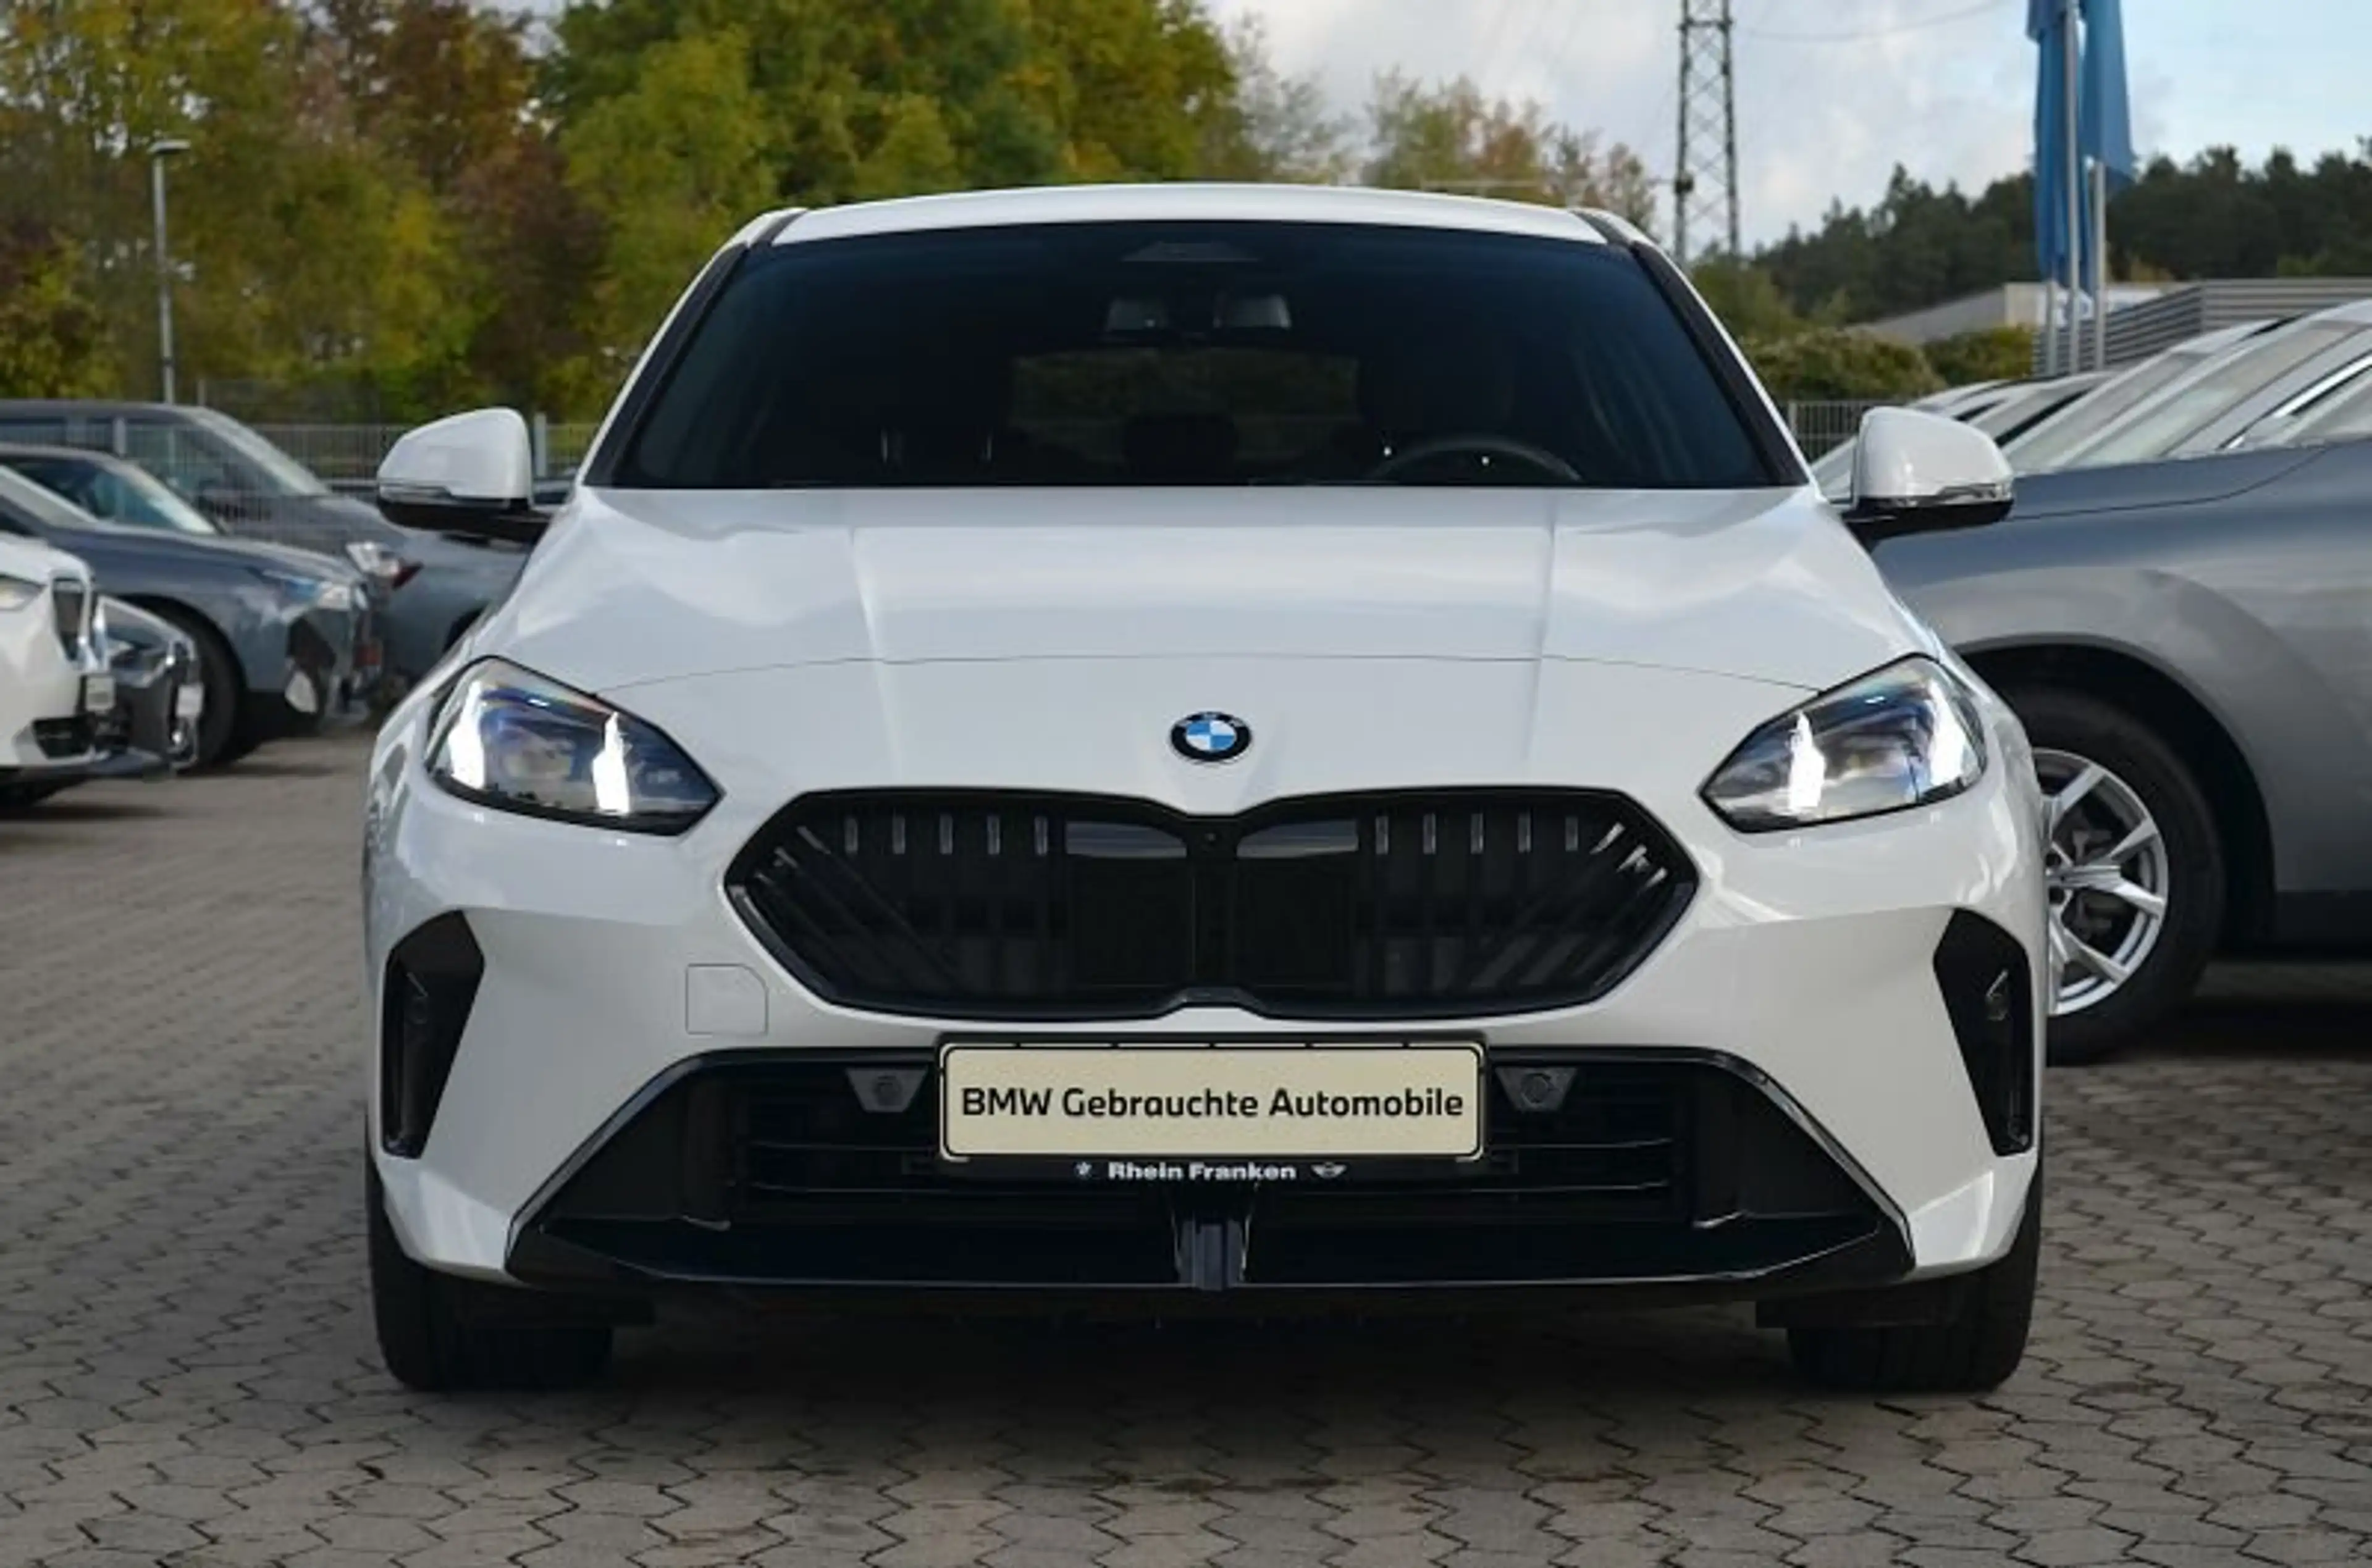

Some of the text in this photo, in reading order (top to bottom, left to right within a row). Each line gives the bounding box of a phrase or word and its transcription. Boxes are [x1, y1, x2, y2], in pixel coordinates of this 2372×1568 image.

[961, 1087, 1463, 1118] BMW Gebrauchte Automobile
[1108, 1160, 1297, 1180] Rhein Franken
